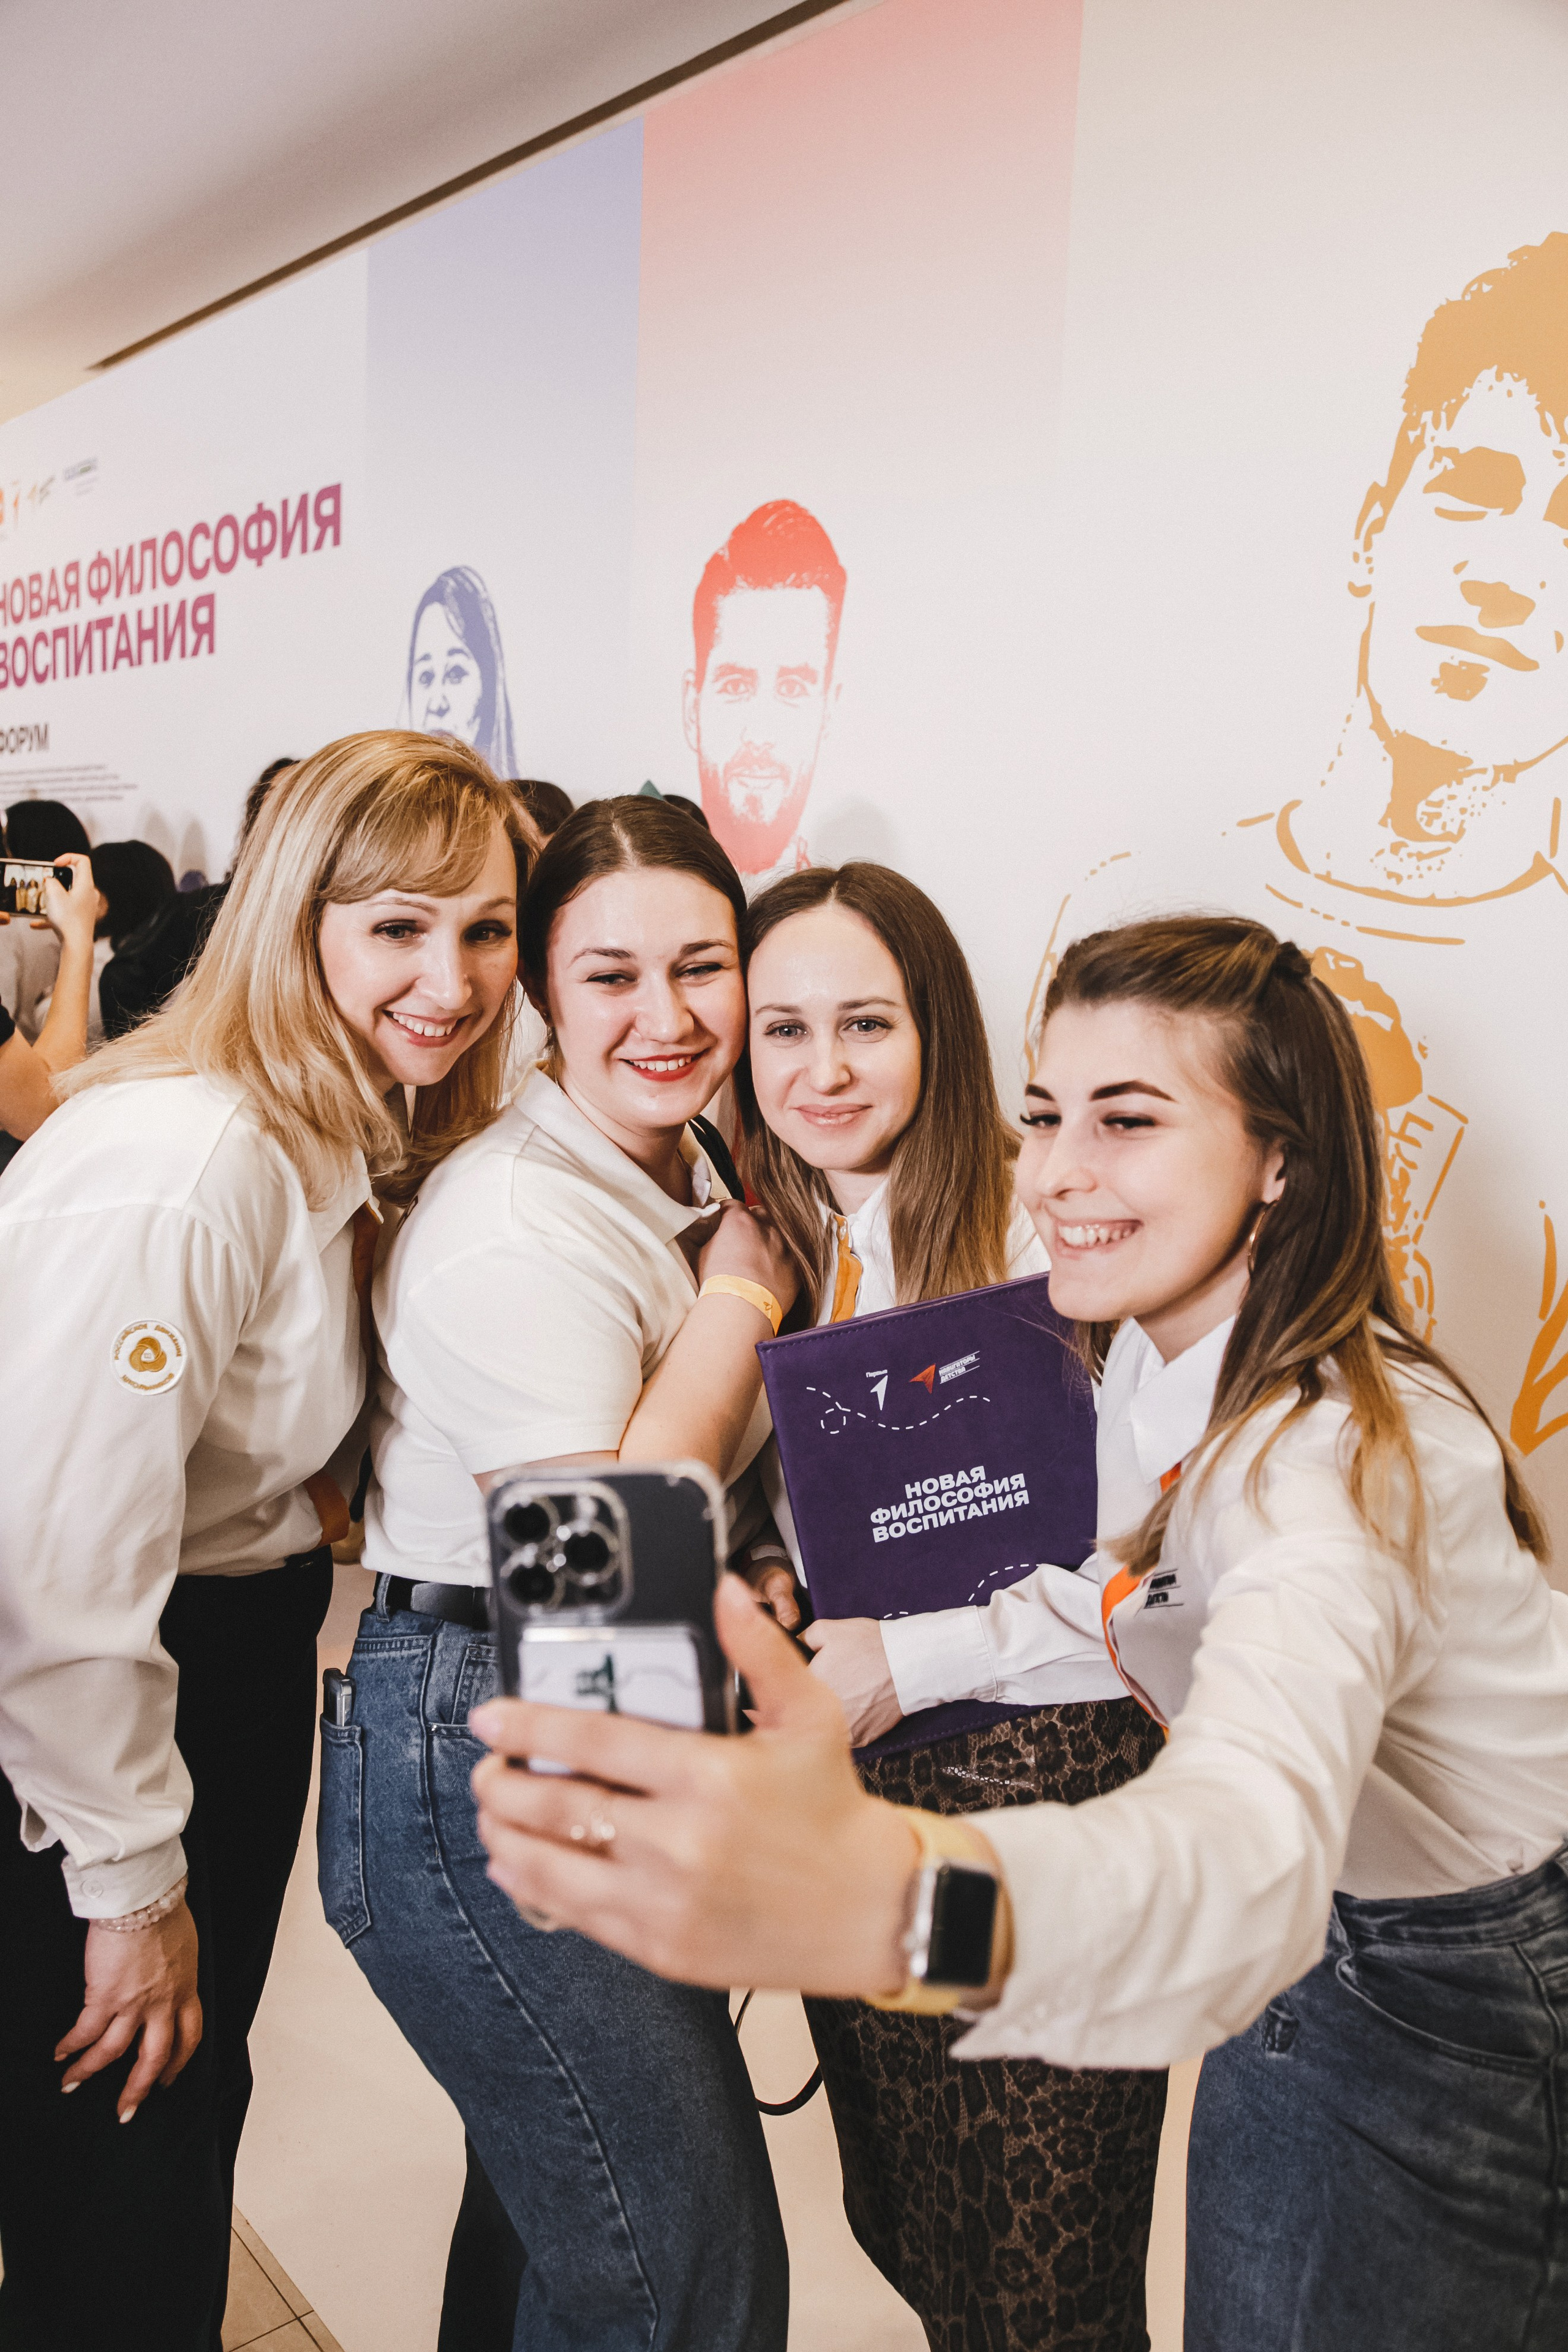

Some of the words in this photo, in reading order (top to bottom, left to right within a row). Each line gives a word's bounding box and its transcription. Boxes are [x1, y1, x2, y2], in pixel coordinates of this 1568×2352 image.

[88, 483, 342, 605] ФИЛОСОФИЯ
[941, 1366, 966, 1384] ДЕТСТВА
[870, 1472, 1026, 1525] ФИЛОСОФИЯ
[905, 1465, 986, 1499] НОВАЯ
[872, 1489, 1030, 1543] ВОСПИТАНИЯ
